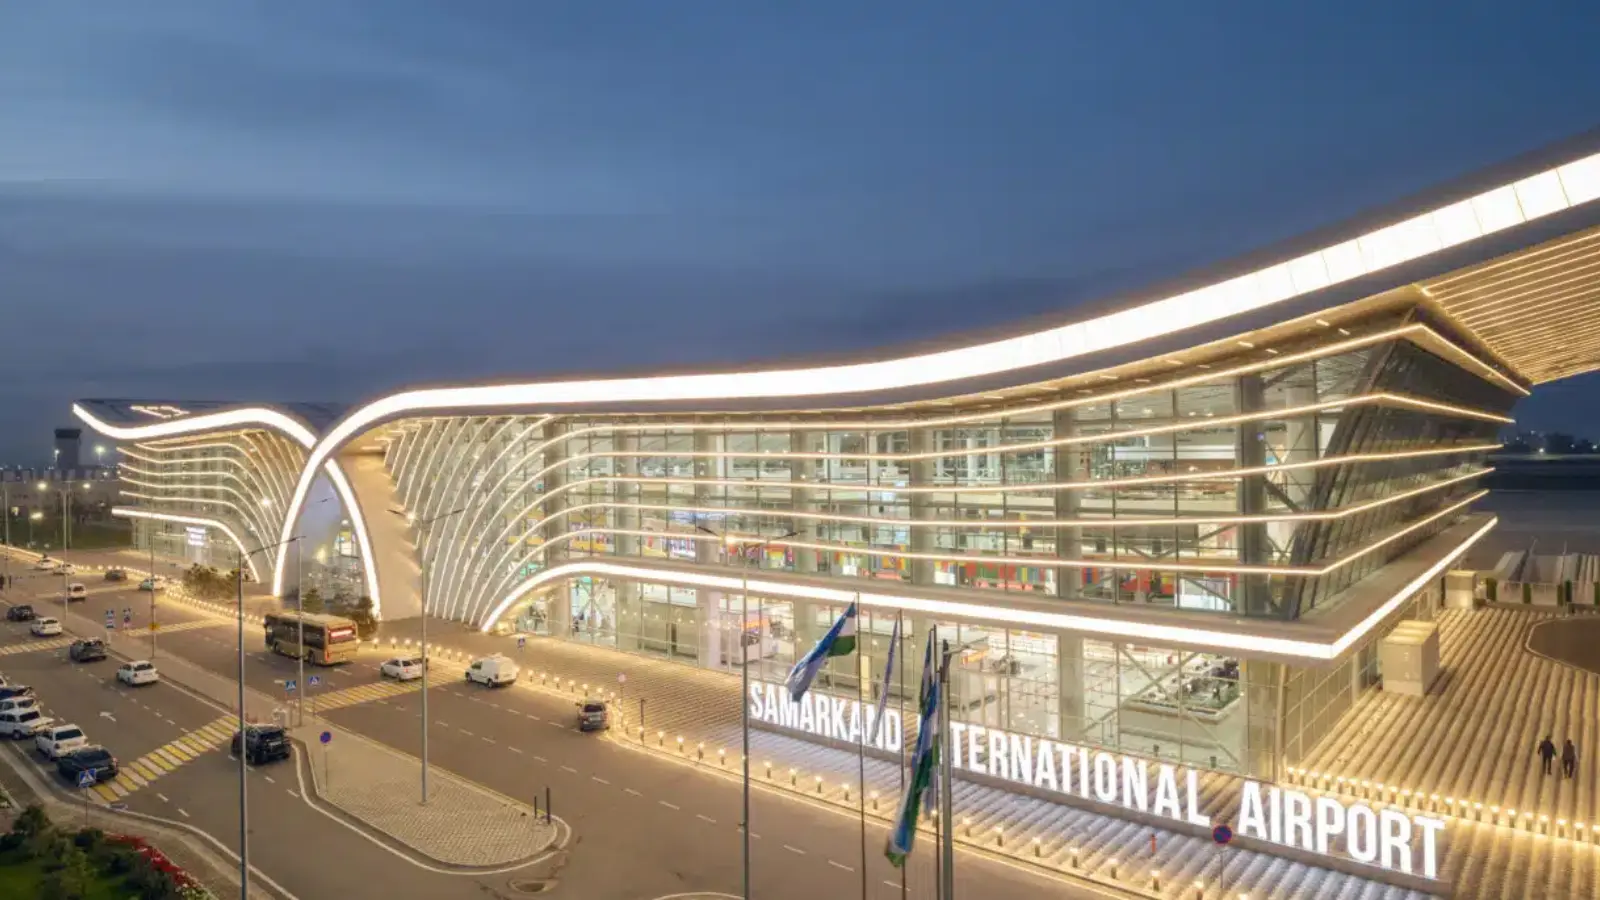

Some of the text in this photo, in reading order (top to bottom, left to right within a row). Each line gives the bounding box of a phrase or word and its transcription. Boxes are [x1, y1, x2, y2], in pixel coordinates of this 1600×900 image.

[750, 680, 1446, 880] SAMARKAND TERNATIONAL AIRPORT
